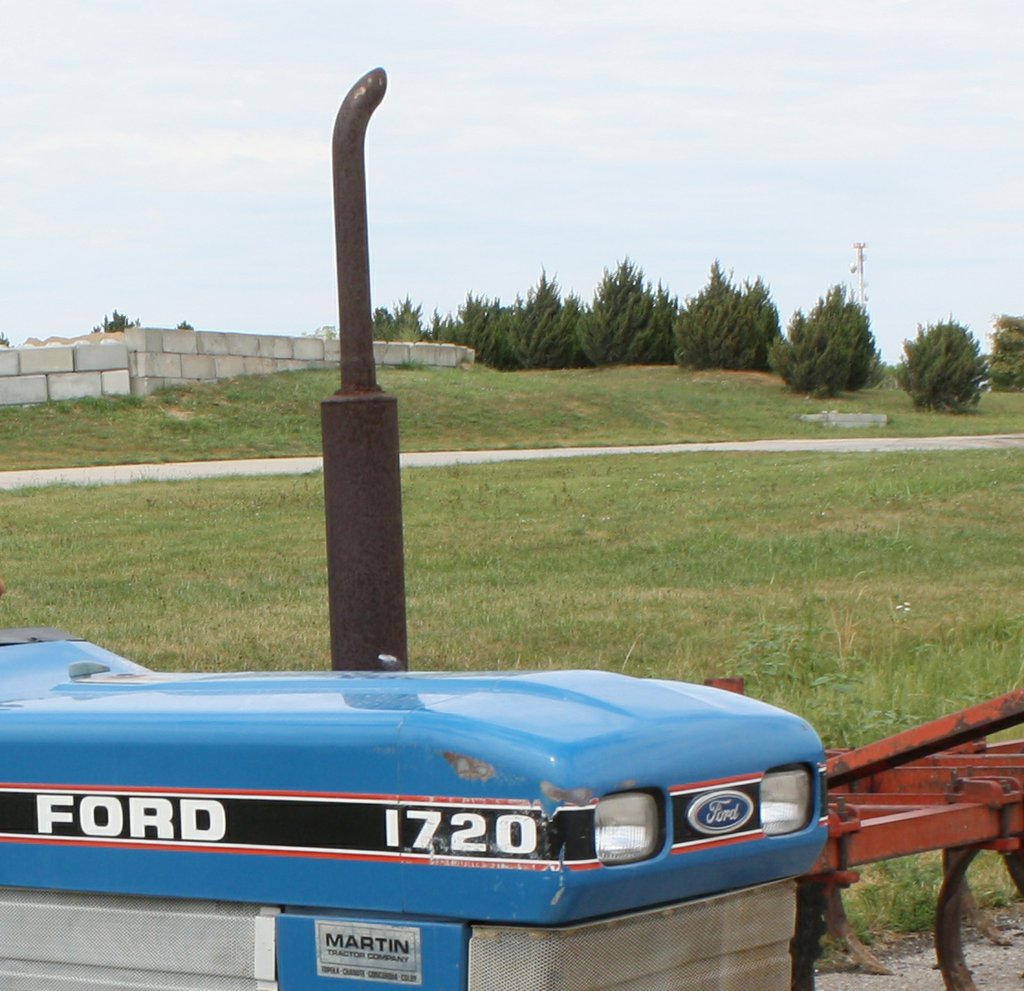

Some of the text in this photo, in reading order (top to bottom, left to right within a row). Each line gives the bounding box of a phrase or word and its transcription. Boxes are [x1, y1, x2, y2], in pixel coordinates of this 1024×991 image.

[36, 794, 227, 841] FORD
[706, 799, 739, 824] Ford
[385, 808, 537, 854] 1720
[326, 933, 409, 954] MARTIN
[328, 949, 409, 962] TRACTOR COMPANY
